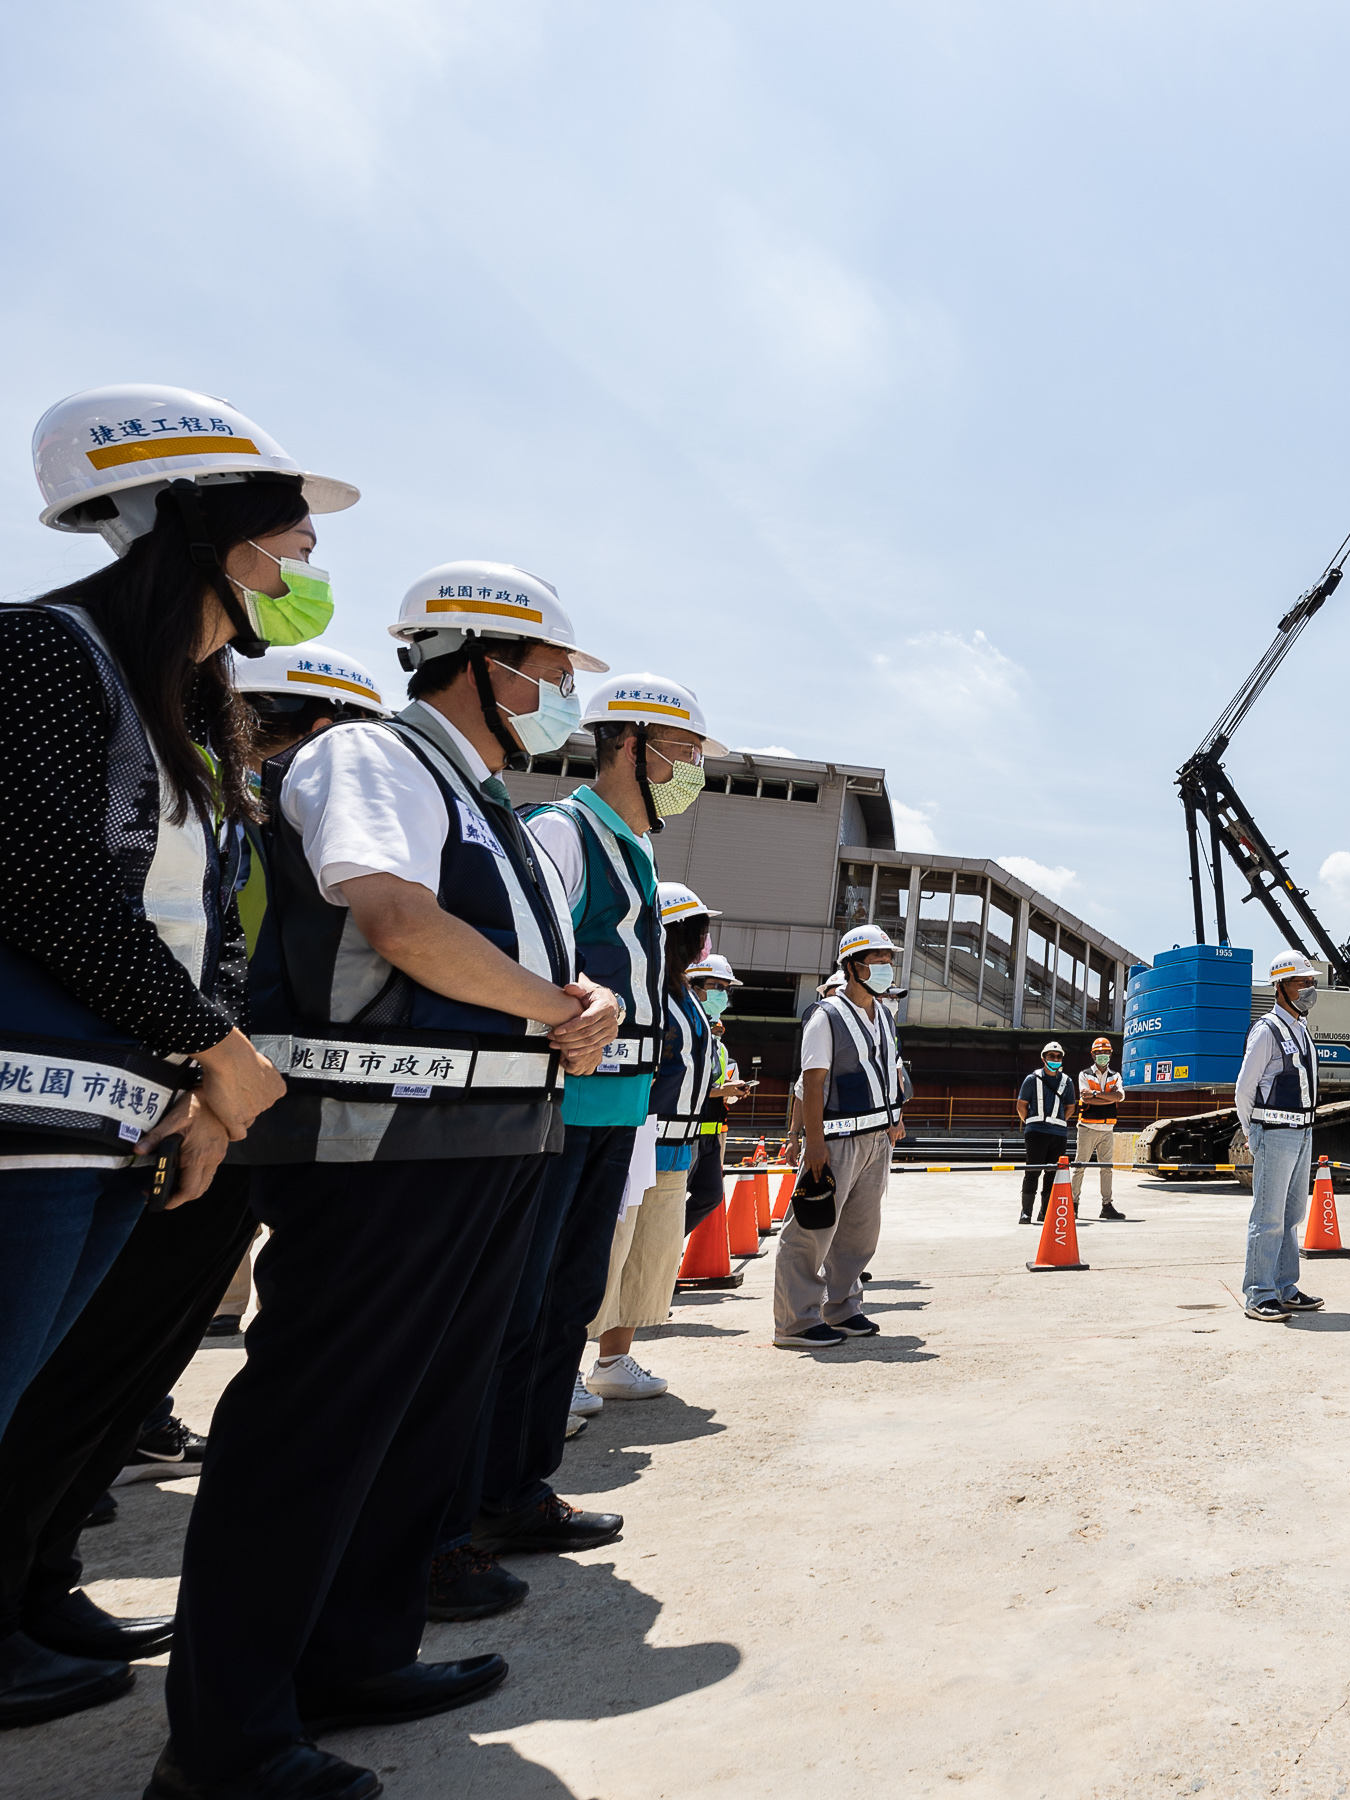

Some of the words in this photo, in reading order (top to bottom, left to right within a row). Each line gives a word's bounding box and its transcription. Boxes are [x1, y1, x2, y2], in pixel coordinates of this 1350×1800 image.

[89, 416, 234, 446] 捷運工程局
[437, 585, 531, 607] 桃園市政府
[297, 660, 374, 690] 捷運工程局
[614, 690, 681, 708] 捷運工程局
[1215, 948, 1233, 957] 1955
[1130, 1017, 1162, 1036] CRANES
[290, 1044, 455, 1081] 桃園市政府
[0, 1061, 160, 1121] 桃園市捷運局
[1054, 1196, 1068, 1246] FOCJV
[1322, 1191, 1334, 1236] FOCJV
